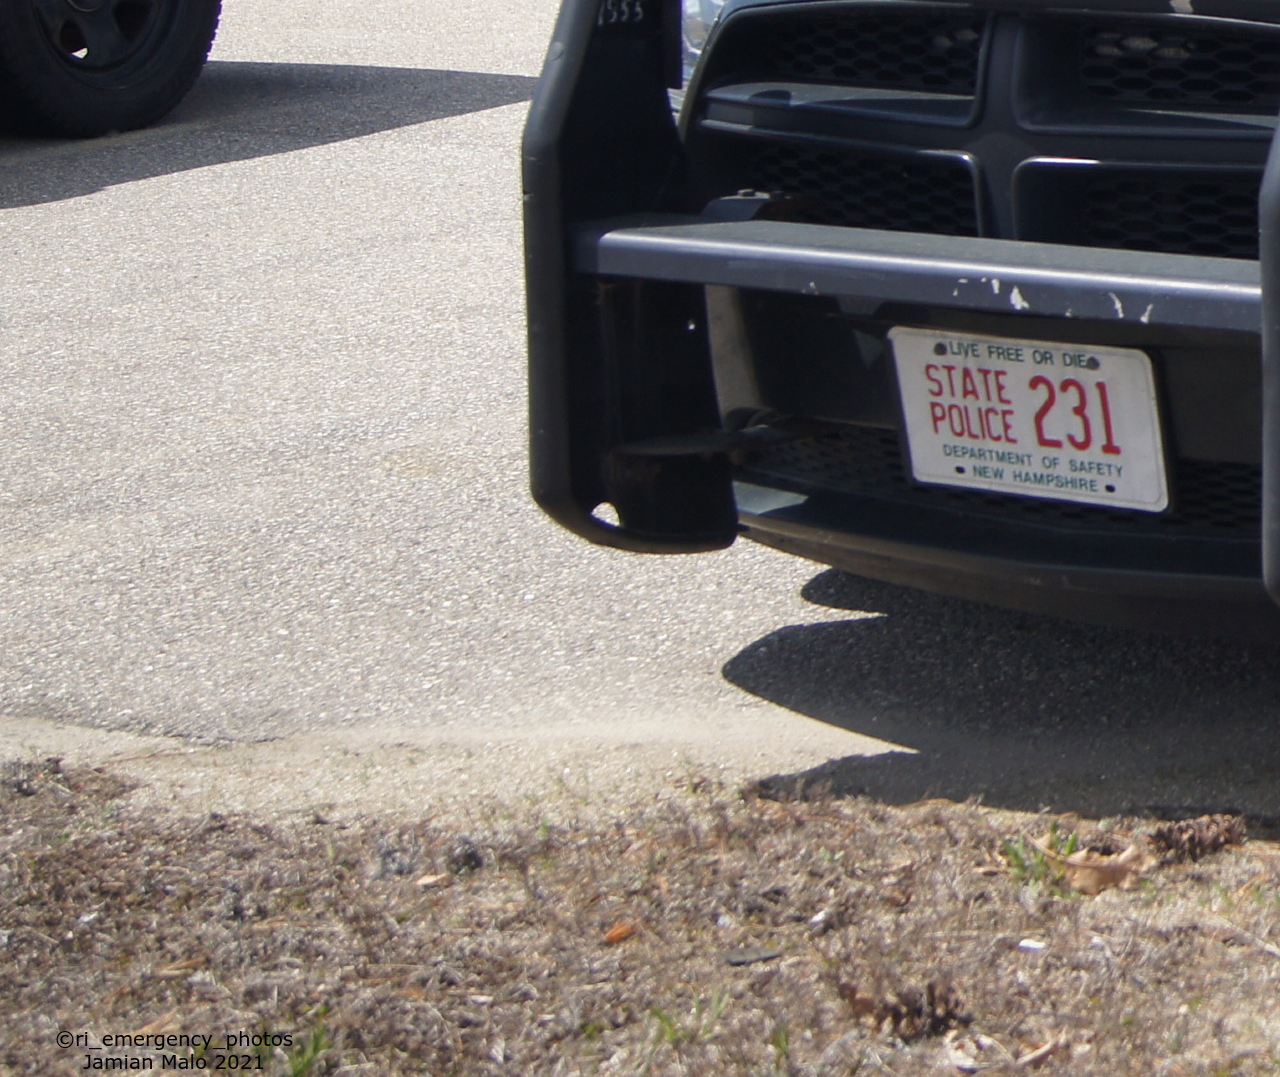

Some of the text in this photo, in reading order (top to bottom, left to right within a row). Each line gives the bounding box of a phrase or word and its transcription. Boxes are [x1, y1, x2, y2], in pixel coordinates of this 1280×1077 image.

[950, 341, 1087, 368] LIVE FREE OR DIE
[925, 364, 1012, 405] STATE
[930, 401, 1018, 444] POLICE
[1029, 375, 1122, 455] 231
[943, 443, 1123, 478] DEPARTMENT OF SAFETY
[973, 465, 1098, 492] NEW HAMPSHIRE
